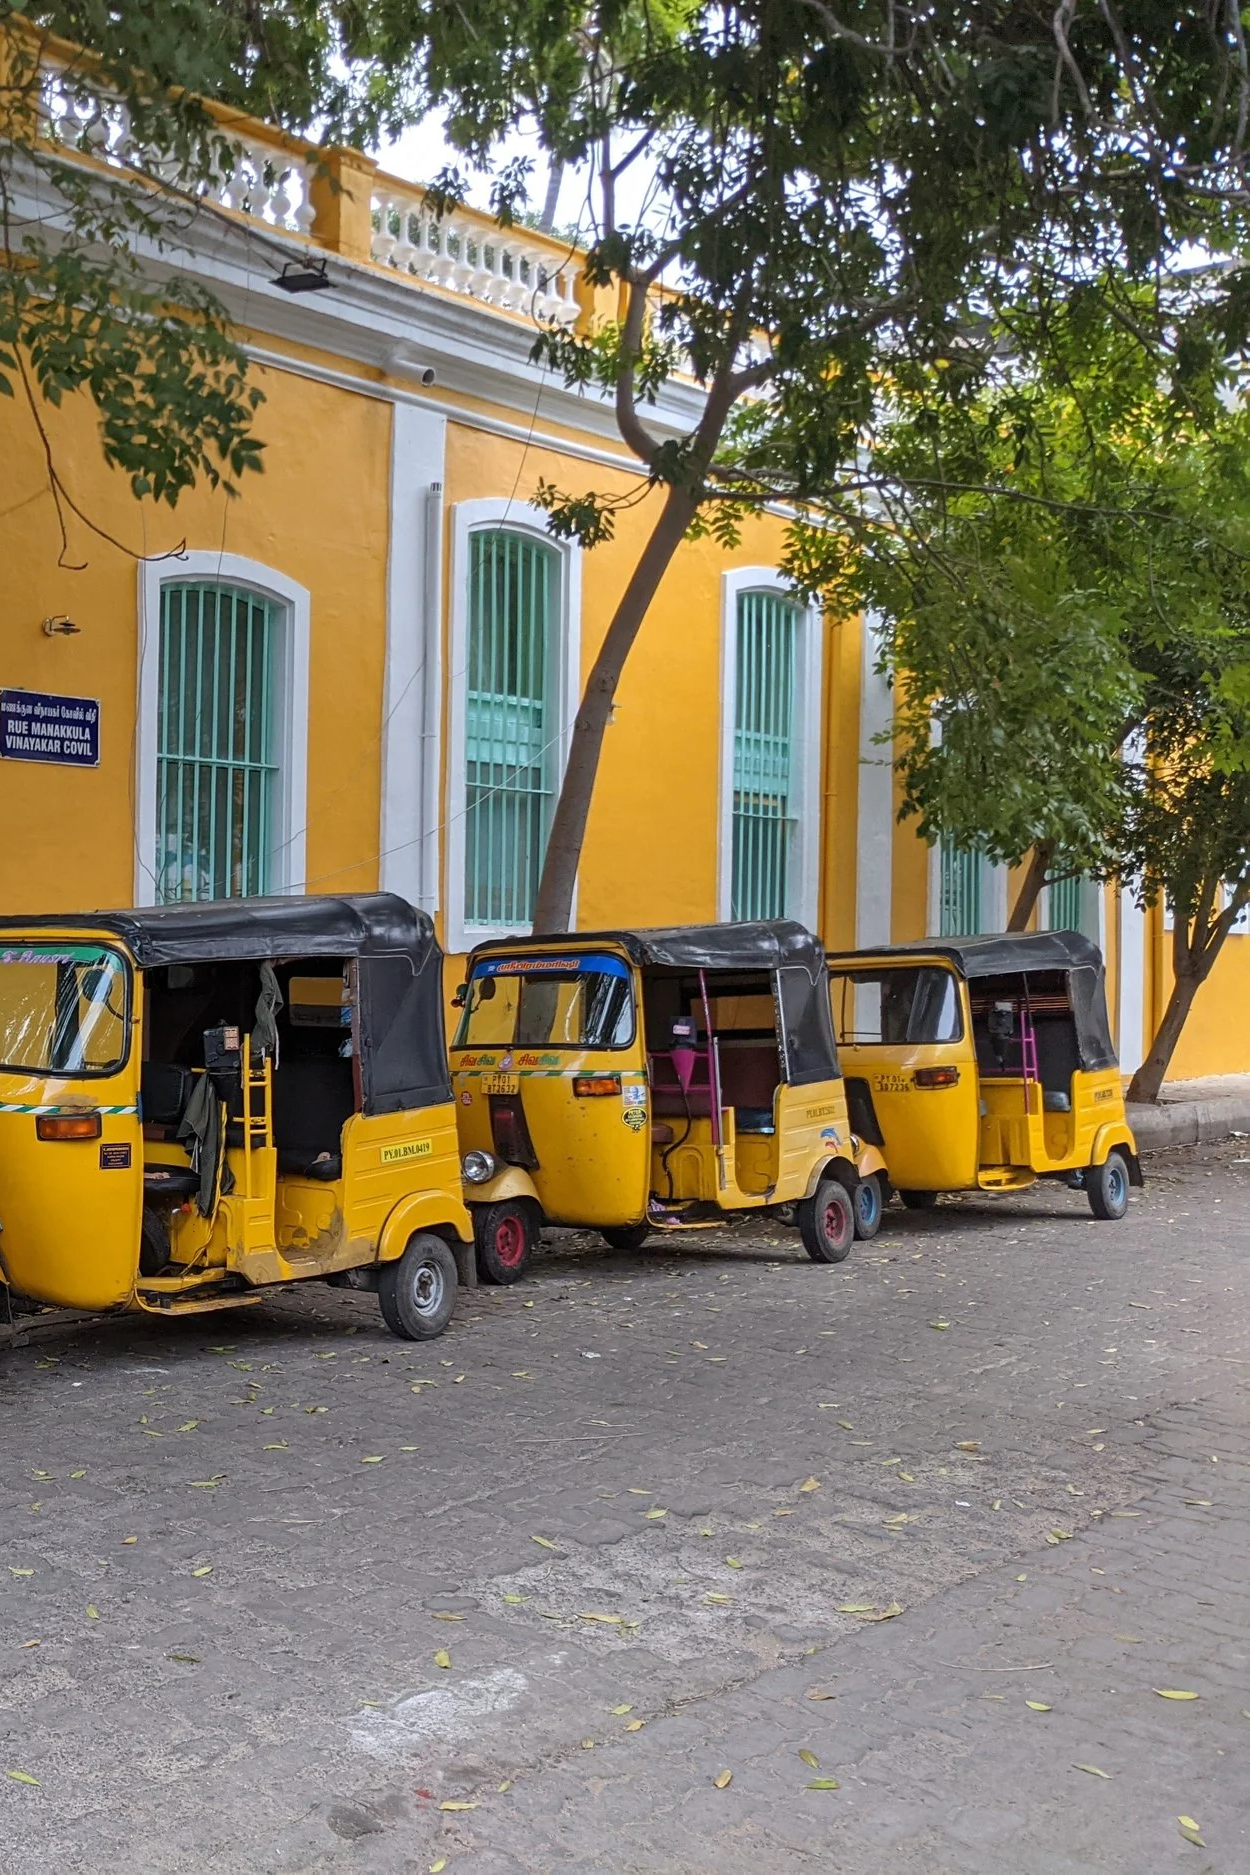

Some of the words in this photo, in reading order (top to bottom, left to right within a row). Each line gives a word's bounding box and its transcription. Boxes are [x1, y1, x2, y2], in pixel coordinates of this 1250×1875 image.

[8, 720, 28, 734] RUE
[32, 722, 90, 740] MANAKKULA
[6, 736, 60, 753] VINAYAKAR
[64, 742, 92, 755] COVIL
